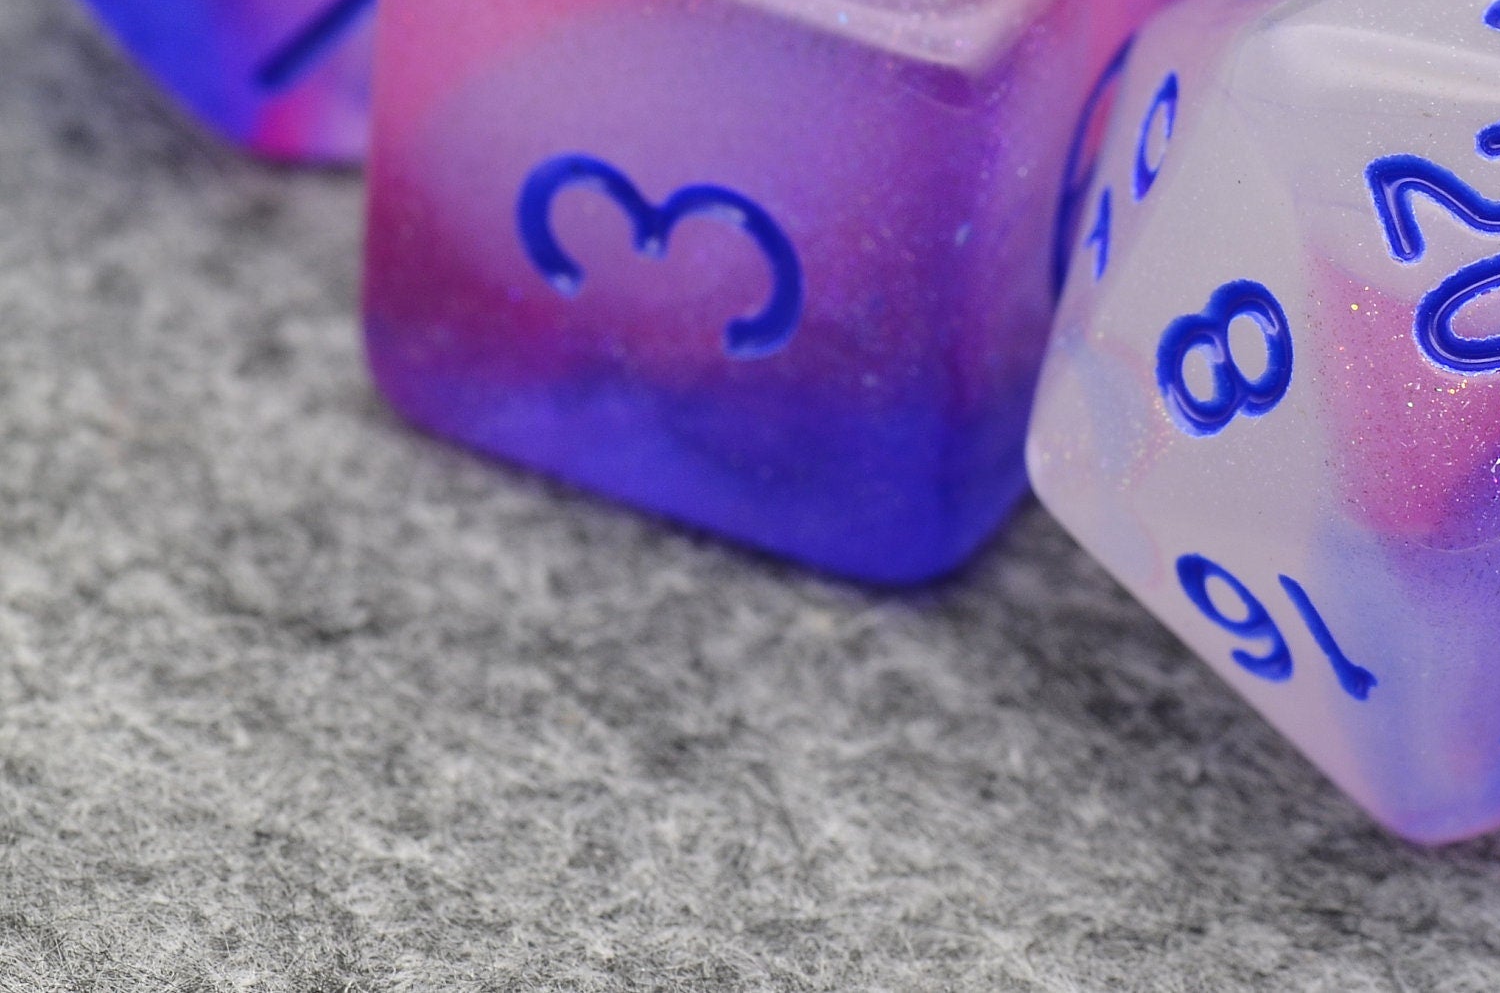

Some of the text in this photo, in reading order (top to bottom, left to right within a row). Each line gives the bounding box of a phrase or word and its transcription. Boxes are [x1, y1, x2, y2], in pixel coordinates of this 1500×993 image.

[513, 151, 806, 361] 3
[1154, 278, 1295, 438] 8
[1175, 552, 1379, 703] 16
